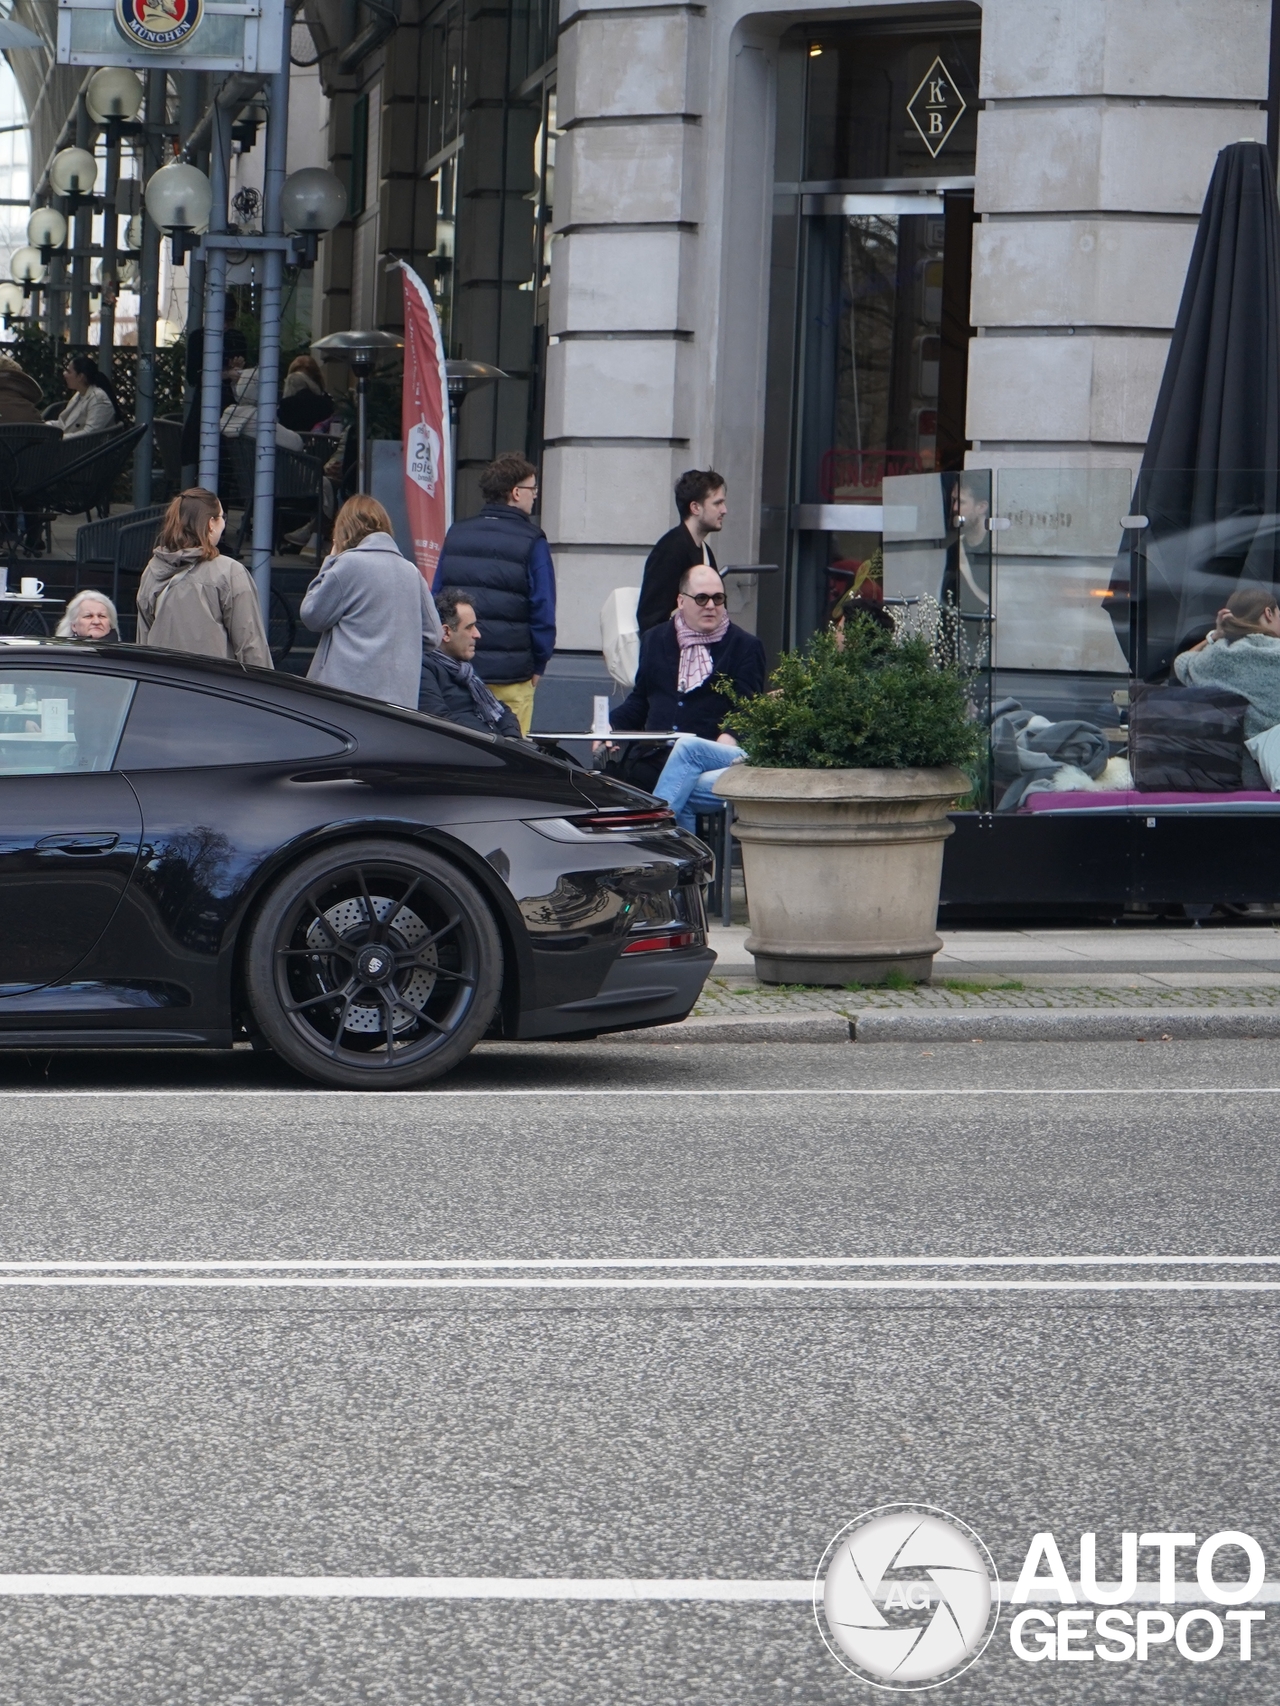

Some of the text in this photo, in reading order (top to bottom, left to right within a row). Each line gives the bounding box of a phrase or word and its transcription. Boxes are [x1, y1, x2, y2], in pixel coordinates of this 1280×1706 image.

[128, 18, 191, 43] MÜNCHEN
[928, 81, 946, 104] K
[928, 112, 943, 134] B
